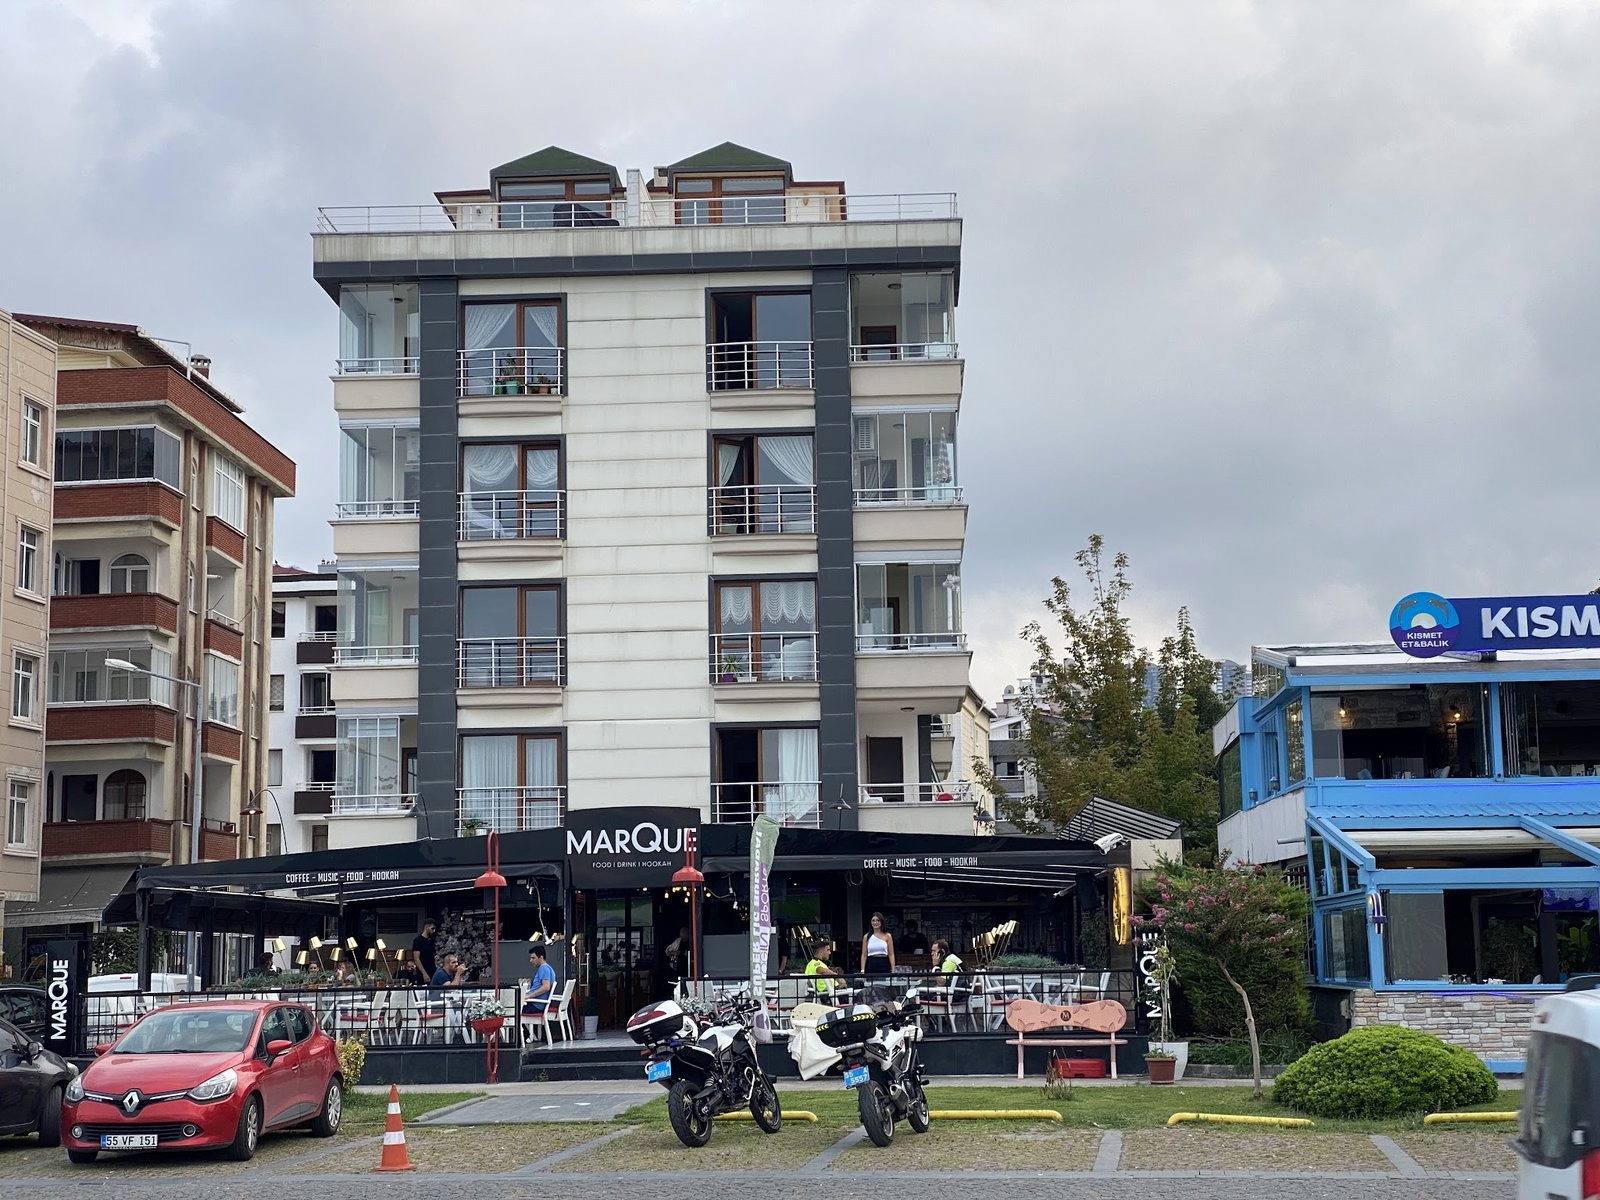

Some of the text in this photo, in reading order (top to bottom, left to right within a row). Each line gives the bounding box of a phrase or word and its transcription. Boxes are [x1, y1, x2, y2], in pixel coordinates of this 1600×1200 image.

[1481, 605, 1600, 638] KISM
[1407, 632, 1442, 640] KISMET
[1401, 640, 1449, 648] ET&BALIK
[566, 822, 697, 855] MARQUE
[592, 861, 612, 869] FOOD
[642, 860, 672, 868] HOOKAH
[863, 856, 978, 868] COFFEE MUSIC FOOD HOOKAH
[285, 871, 399, 883] COFFEE MUSIC FOOD HOOKAH
[48, 960, 69, 1040] MARQUE
[106, 1136, 156, 1146] 55 VF 151
